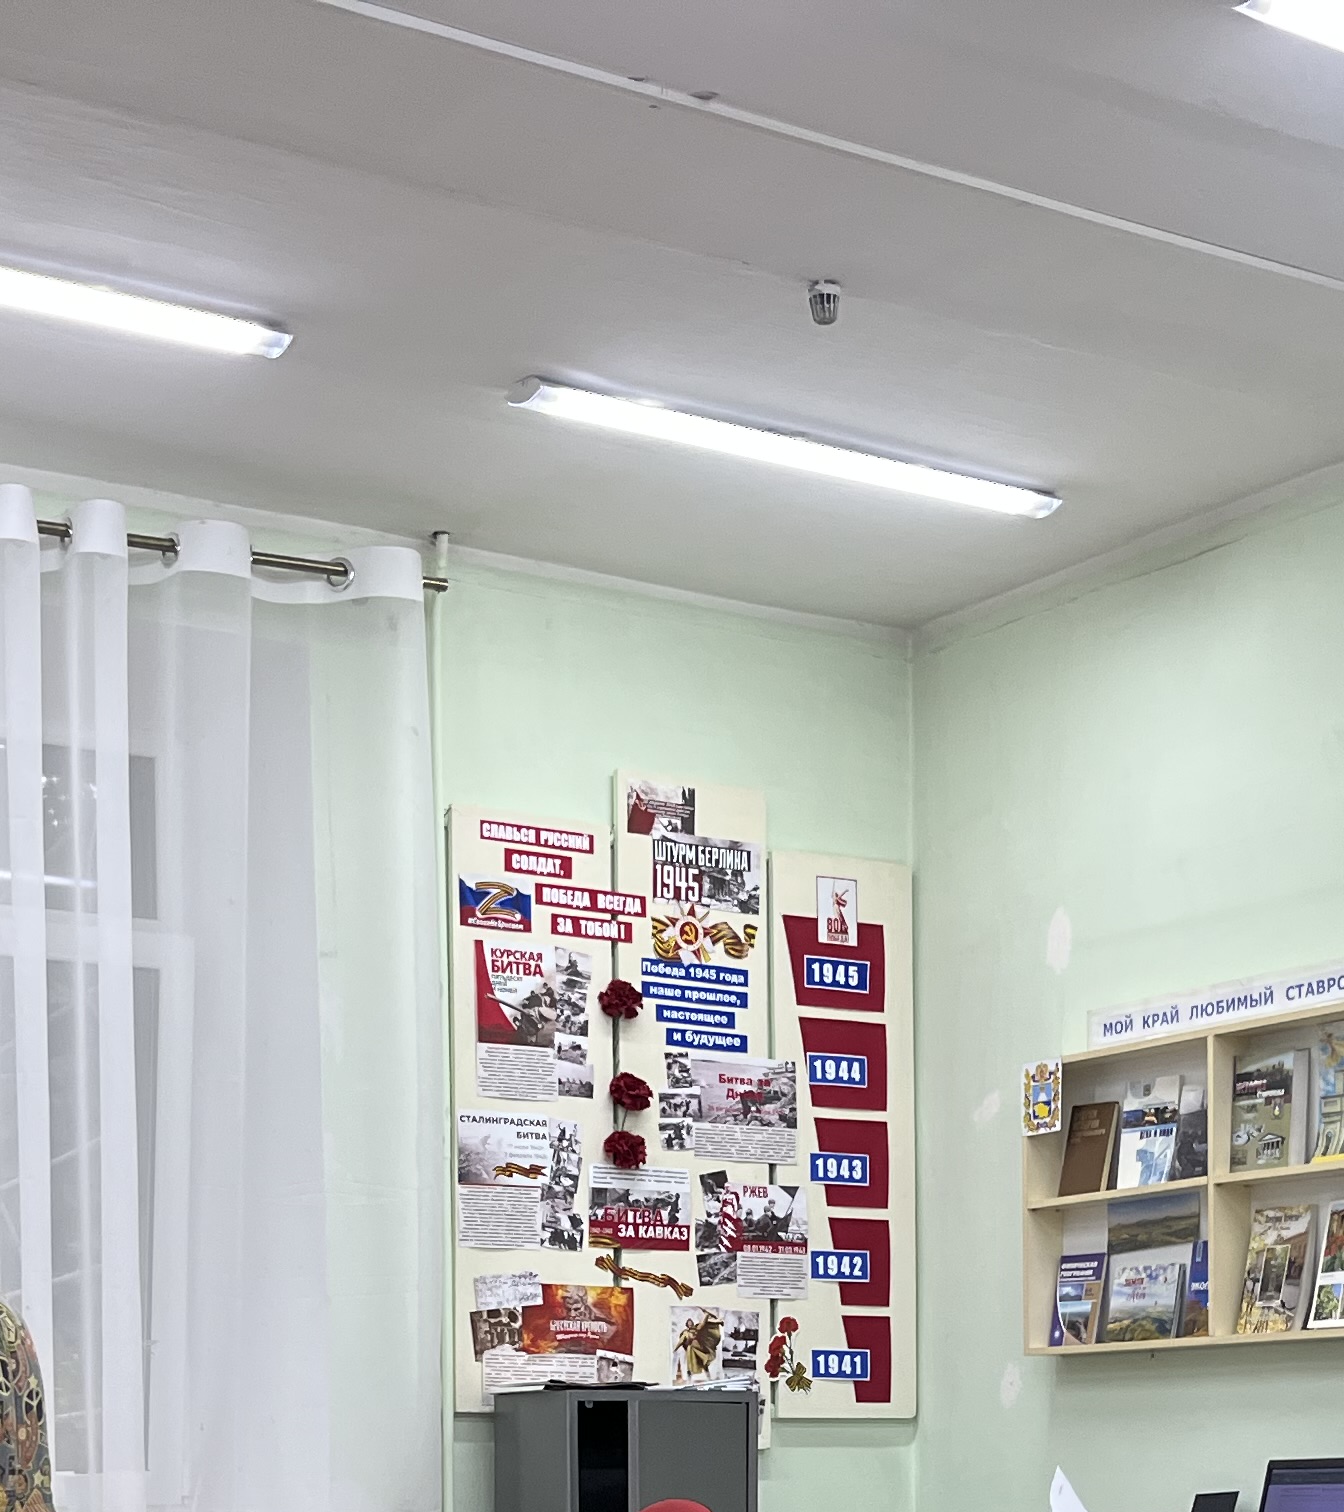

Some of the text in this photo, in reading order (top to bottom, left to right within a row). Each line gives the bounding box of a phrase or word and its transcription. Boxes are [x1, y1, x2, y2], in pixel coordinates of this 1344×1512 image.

[482, 823, 590, 851] СЛАВЬСЯ РУССКИЙ
[512, 853, 564, 875] СОЛДАТ,
[654, 840, 748, 871] ШТУРМ БЕРЛИНА
[656, 864, 699, 901] 1945
[542, 887, 642, 914] ПОБЕДА ВСЕГДА
[557, 918, 573, 933] ЗА
[491, 948, 543, 963] КУРСКАЯ
[491, 959, 544, 977] БИТВА
[642, 961, 744, 984] Победа 1945 года
[812, 962, 858, 986] 1945
[650, 986, 740, 1006] наше прошлое,
[663, 1010, 728, 1024] настоящее
[1103, 1013, 1134, 1037] МОЙ
[1142, 1005, 1180, 1030] КРАЙ
[1189, 987, 1274, 1021] ЛЮБИМЫЙ
[673, 1031, 740, 1047] и будущее
[719, 1074, 752, 1085] Битва
[814, 1059, 860, 1082] 1944
[460, 1115, 547, 1127] СТАЛИНГРАДСКАЯ
[516, 1132, 547, 1140] БИТВА
[816, 1158, 862, 1179] 1943
[743, 1186, 768, 1198] РЖЕВ
[603, 1207, 663, 1225] БИТВА
[618, 1224, 688, 1240] ЗА КАВКАЗ
[816, 1256, 863, 1276] 1942
[817, 1354, 861, 1375] 1941
